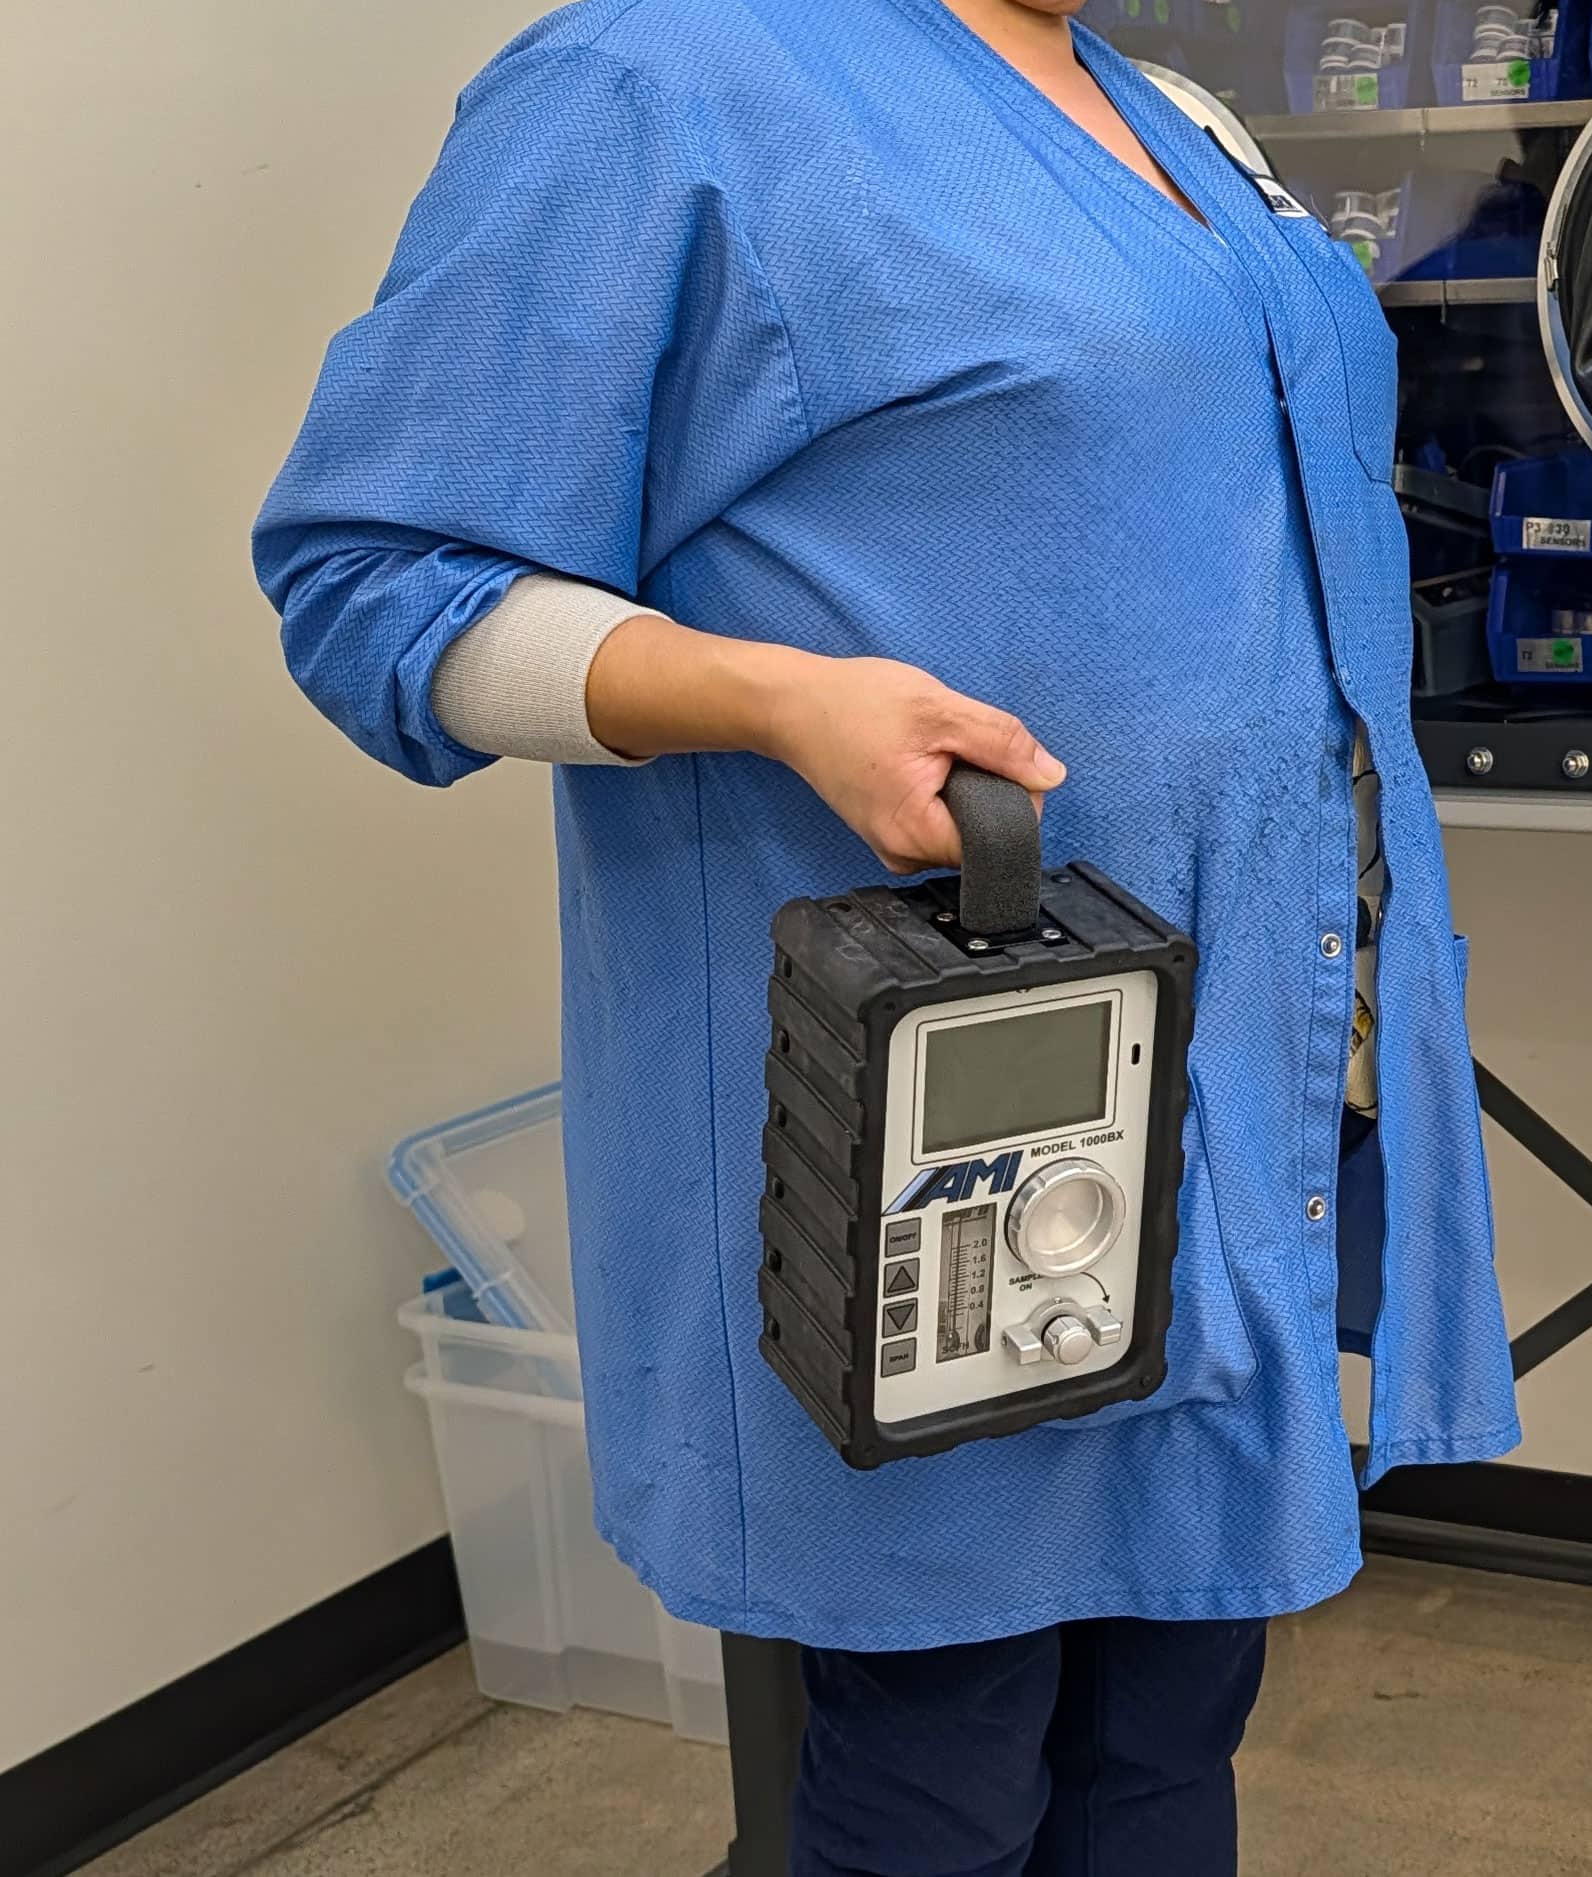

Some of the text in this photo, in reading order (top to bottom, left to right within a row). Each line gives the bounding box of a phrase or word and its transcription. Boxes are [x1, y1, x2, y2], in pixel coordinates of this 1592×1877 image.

[1540, 536, 1587, 547] SENSORS
[1030, 1130, 1125, 1159] MODEL 1000BX
[907, 1150, 1024, 1211] AMI
[972, 1238, 987, 1249] 2.0
[972, 1254, 986, 1264] 1.6
[971, 1269, 986, 1279] 1.2
[970, 1284, 985, 1295] 0.8
[1019, 1283, 1032, 1292] ON
[969, 1300, 984, 1310] 0.4
